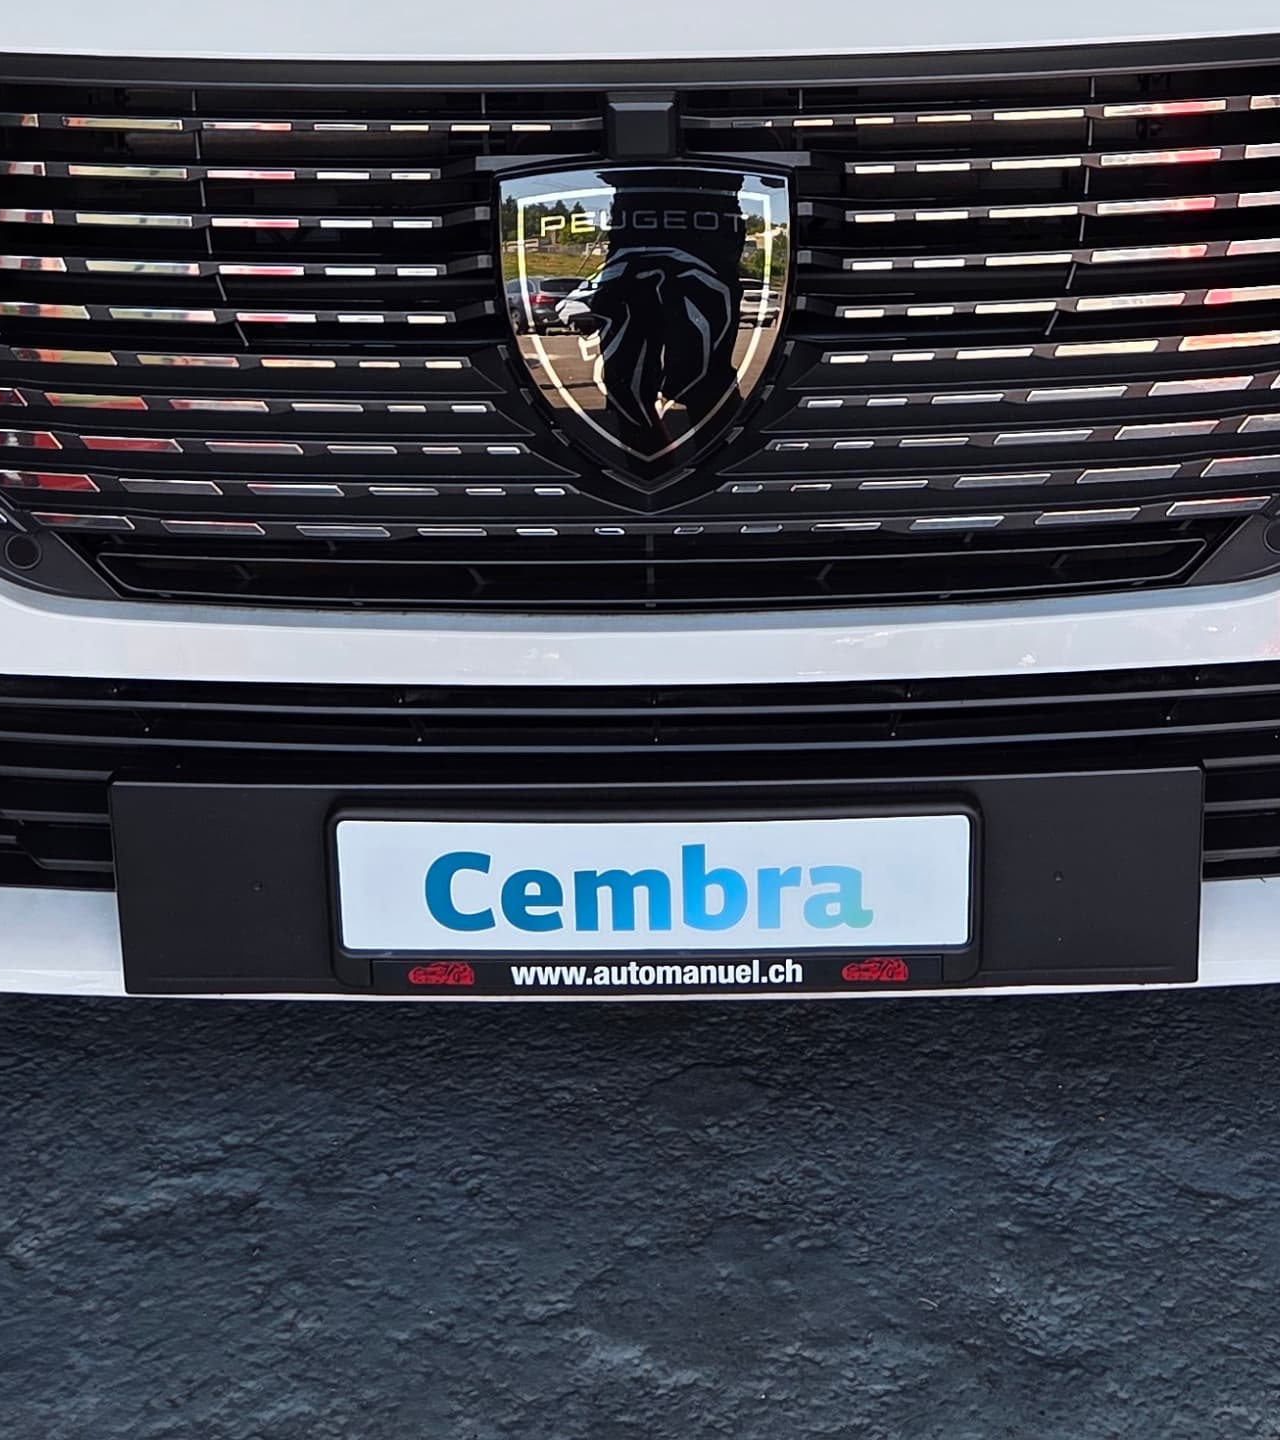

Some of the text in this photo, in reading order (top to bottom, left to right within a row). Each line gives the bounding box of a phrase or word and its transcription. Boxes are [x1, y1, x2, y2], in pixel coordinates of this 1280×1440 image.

[540, 209, 748, 237] PEUGEOT
[423, 843, 874, 933] Cembra
[511, 959, 802, 986] www.automanuel.ch
